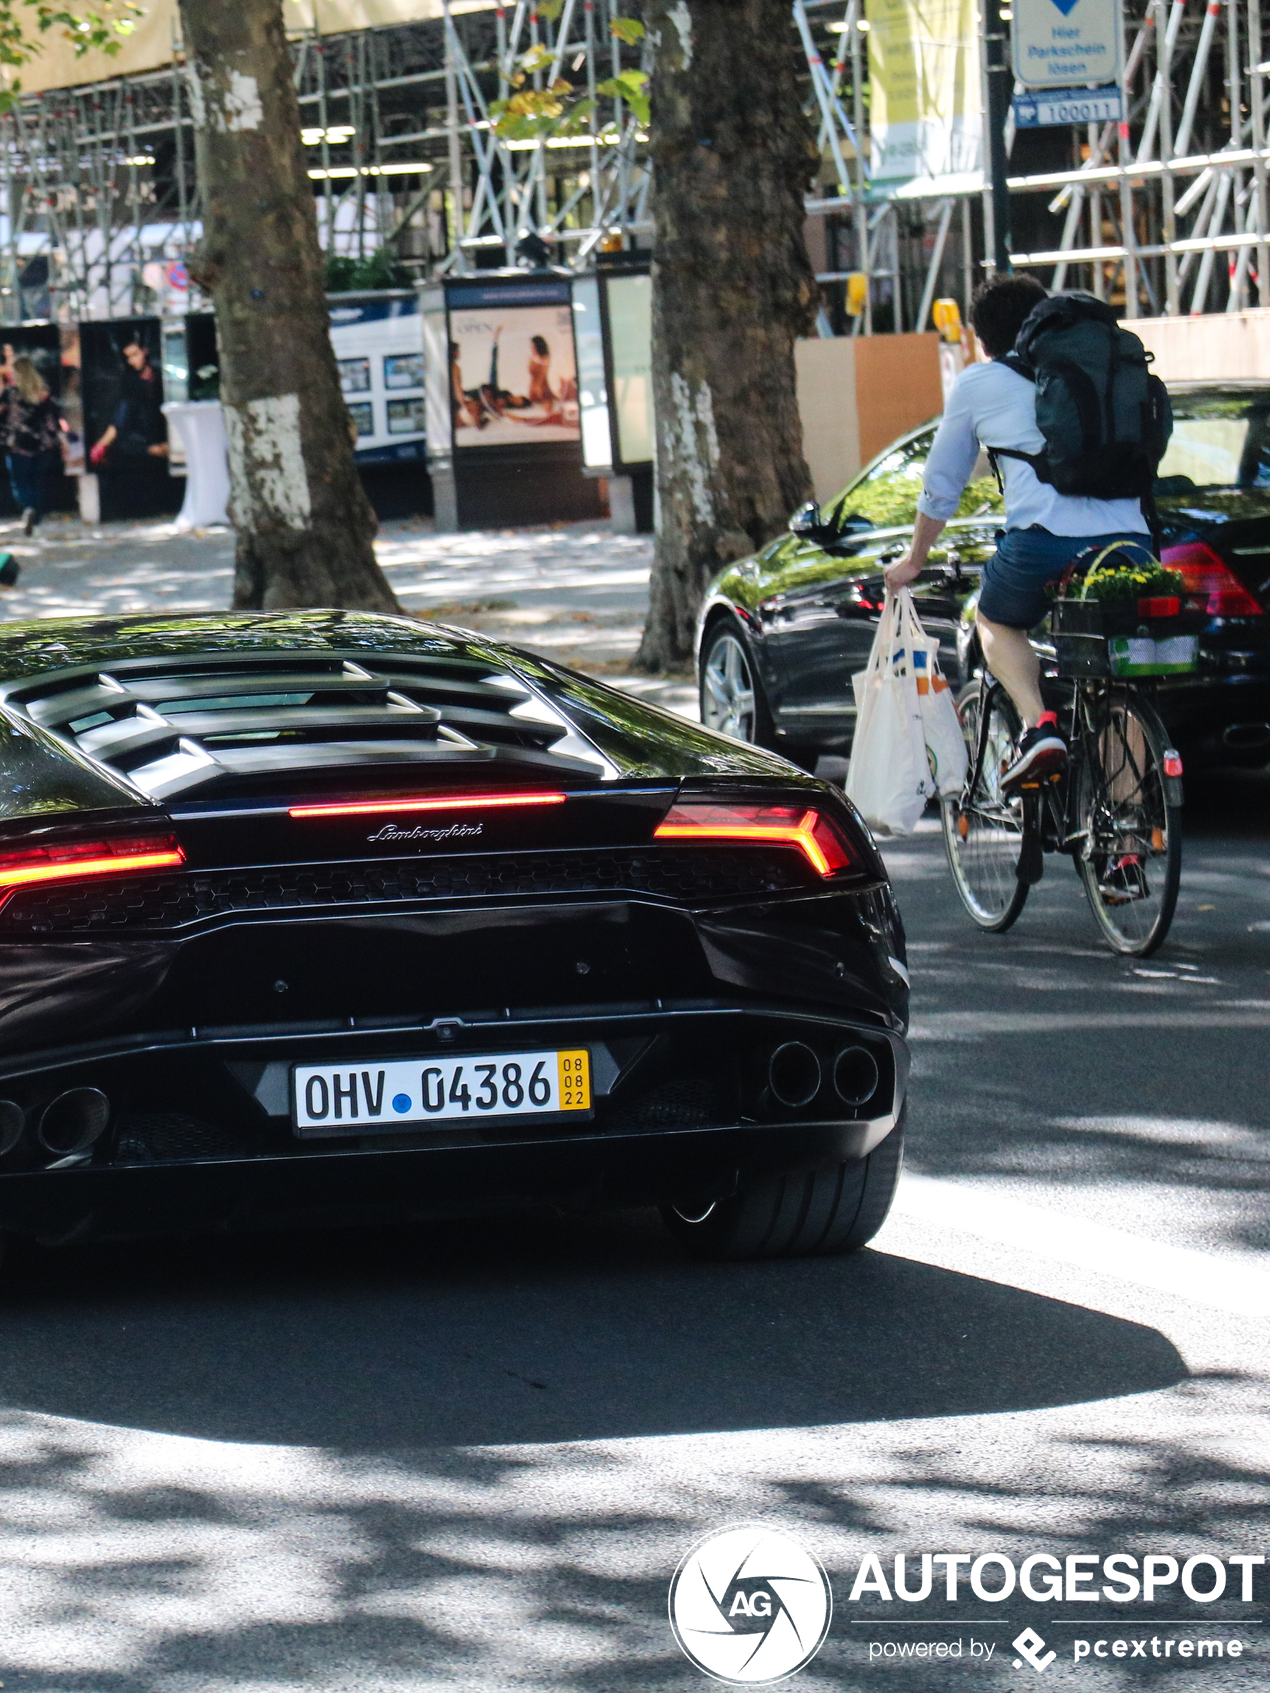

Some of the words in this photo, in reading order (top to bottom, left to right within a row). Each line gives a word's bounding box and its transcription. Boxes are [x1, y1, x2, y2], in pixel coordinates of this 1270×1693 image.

[1052, 28, 1080, 39] Hier
[1028, 44, 1106, 59] Parkschein
[1049, 62, 1087, 75] lösen
[1049, 103, 1110, 122] 100011
[367, 823, 484, 842] Lamborghini
[563, 1057, 582, 1072] 08
[564, 1074, 583, 1088] 08
[305, 1070, 386, 1120] OHV
[421, 1060, 551, 1113] 04386
[565, 1091, 584, 1105] 22
